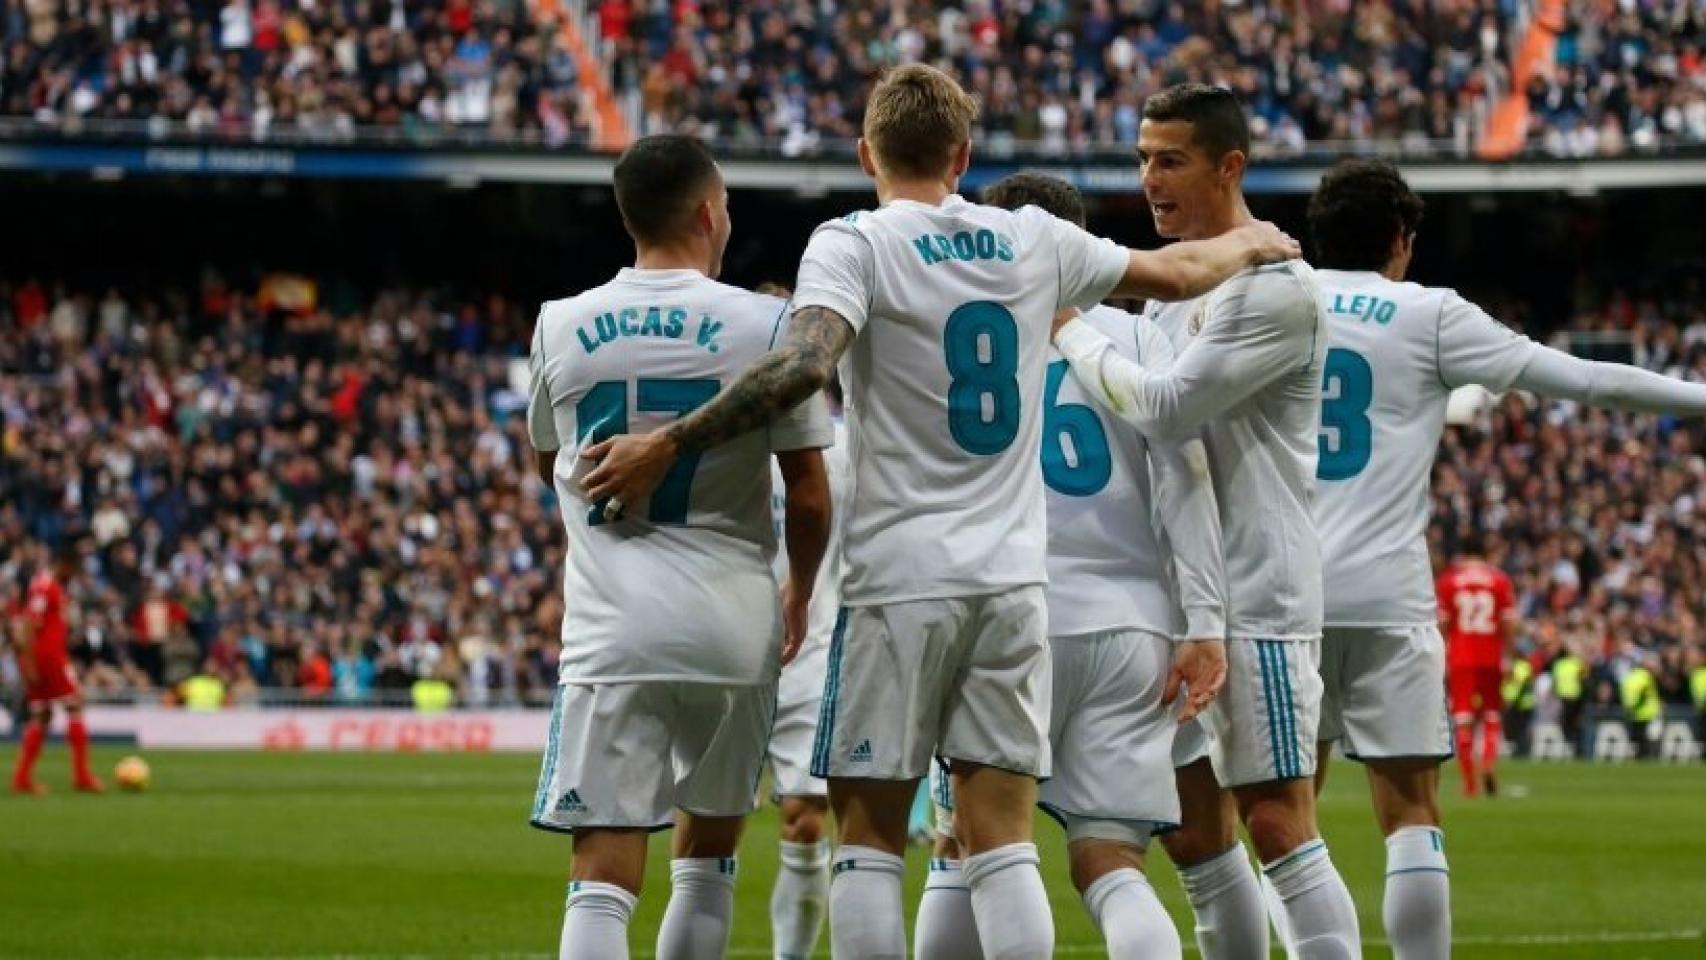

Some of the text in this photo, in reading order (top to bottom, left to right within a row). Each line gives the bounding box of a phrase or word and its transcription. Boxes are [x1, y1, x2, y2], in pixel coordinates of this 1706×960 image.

[912, 229, 1014, 265] KROOS
[576, 306, 723, 354] LUCAS V.
[1327, 293, 1398, 325] LEJO
[944, 301, 1020, 455] 8
[1041, 360, 1112, 497] 6
[1316, 347, 1374, 481] 3
[1453, 590, 1497, 635] 12
